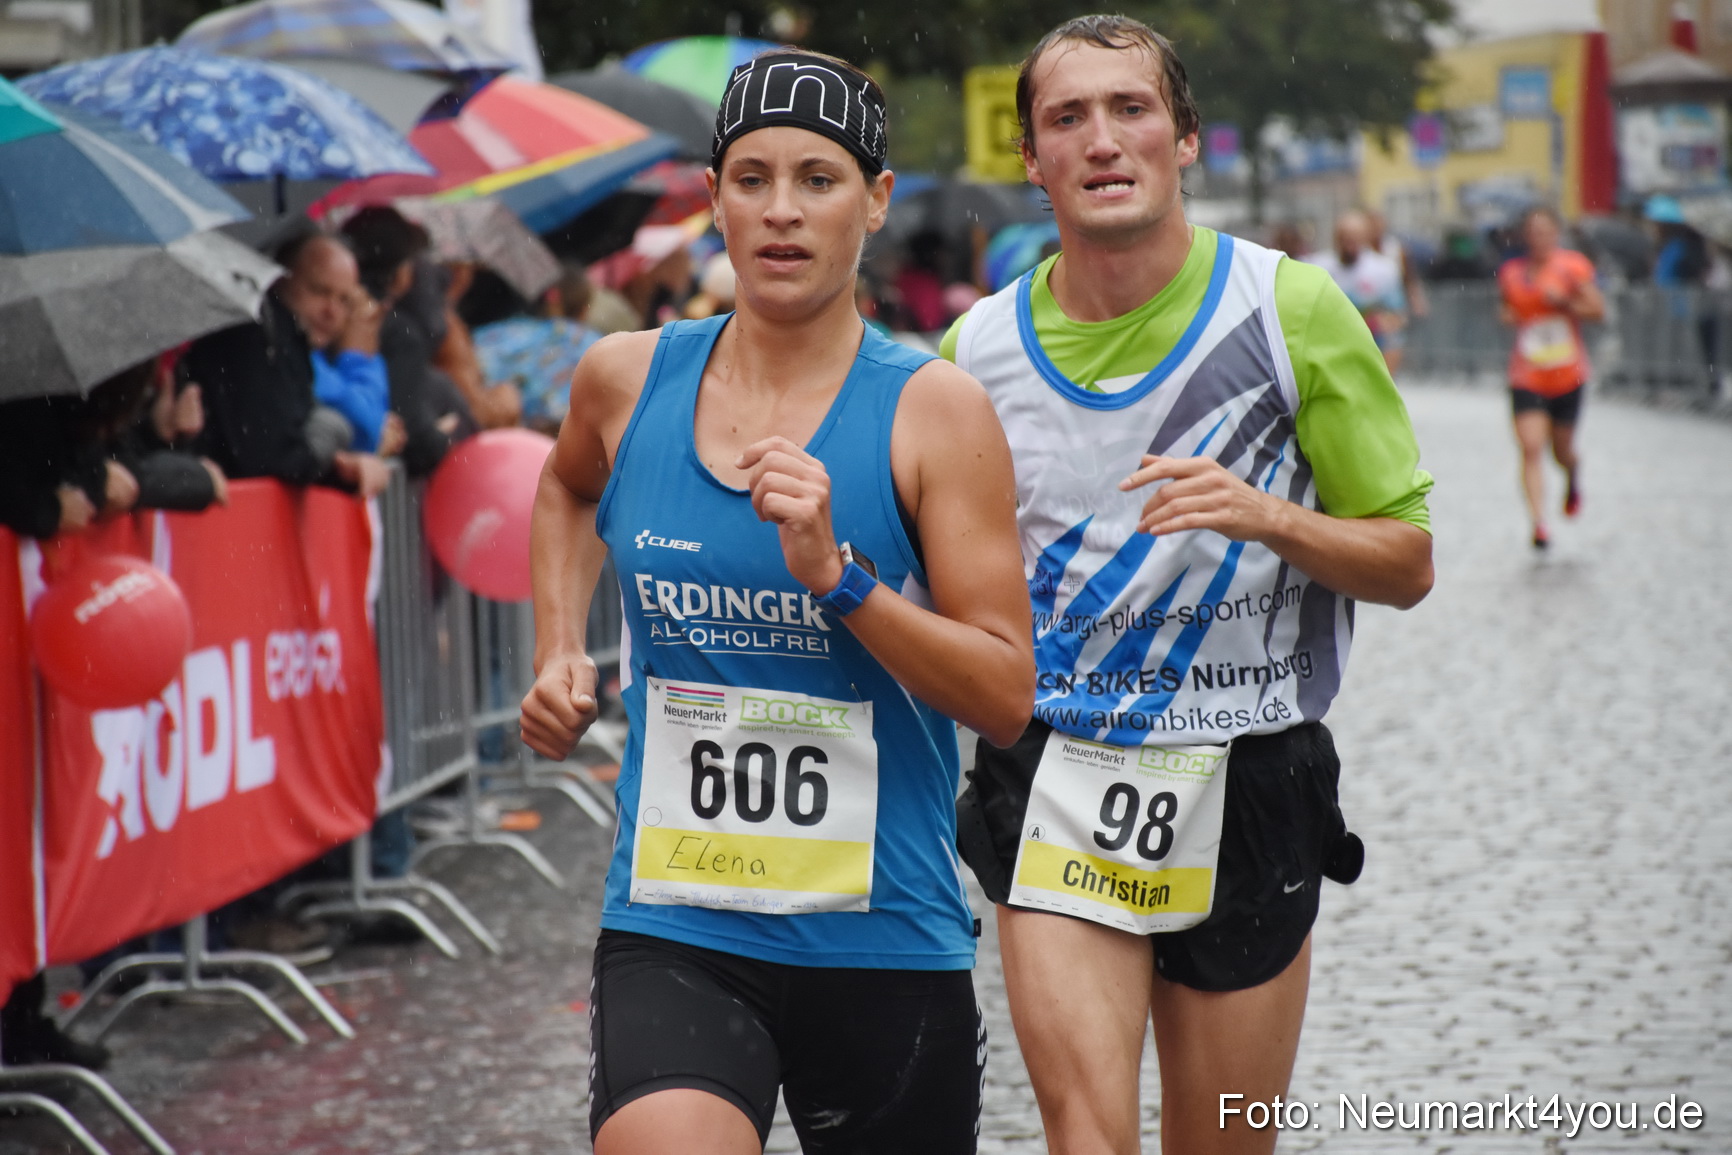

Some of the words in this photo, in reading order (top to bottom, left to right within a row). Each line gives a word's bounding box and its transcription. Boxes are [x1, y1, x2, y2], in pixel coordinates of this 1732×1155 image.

[647, 535, 702, 552] CUBE
[634, 573, 831, 631] ERDINGER
[1035, 664, 1077, 695] ON
[1086, 667, 1181, 697] BIKES
[663, 704, 727, 723] NeuerMarkt
[739, 695, 852, 730] BOCK
[1034, 696, 1292, 732] ww.aironbikes.de
[738, 722, 774, 733] inspired
[775, 725, 787, 735] by
[788, 728, 815, 737] smart
[1062, 743, 1126, 766] NeuerMarkt
[690, 739, 829, 827] 606
[1136, 767, 1167, 781] inspired
[1167, 774, 1177, 783] by
[1031, 826, 1040, 839] A
[1093, 782, 1178, 861] 98
[1062, 859, 1170, 908] Christian
